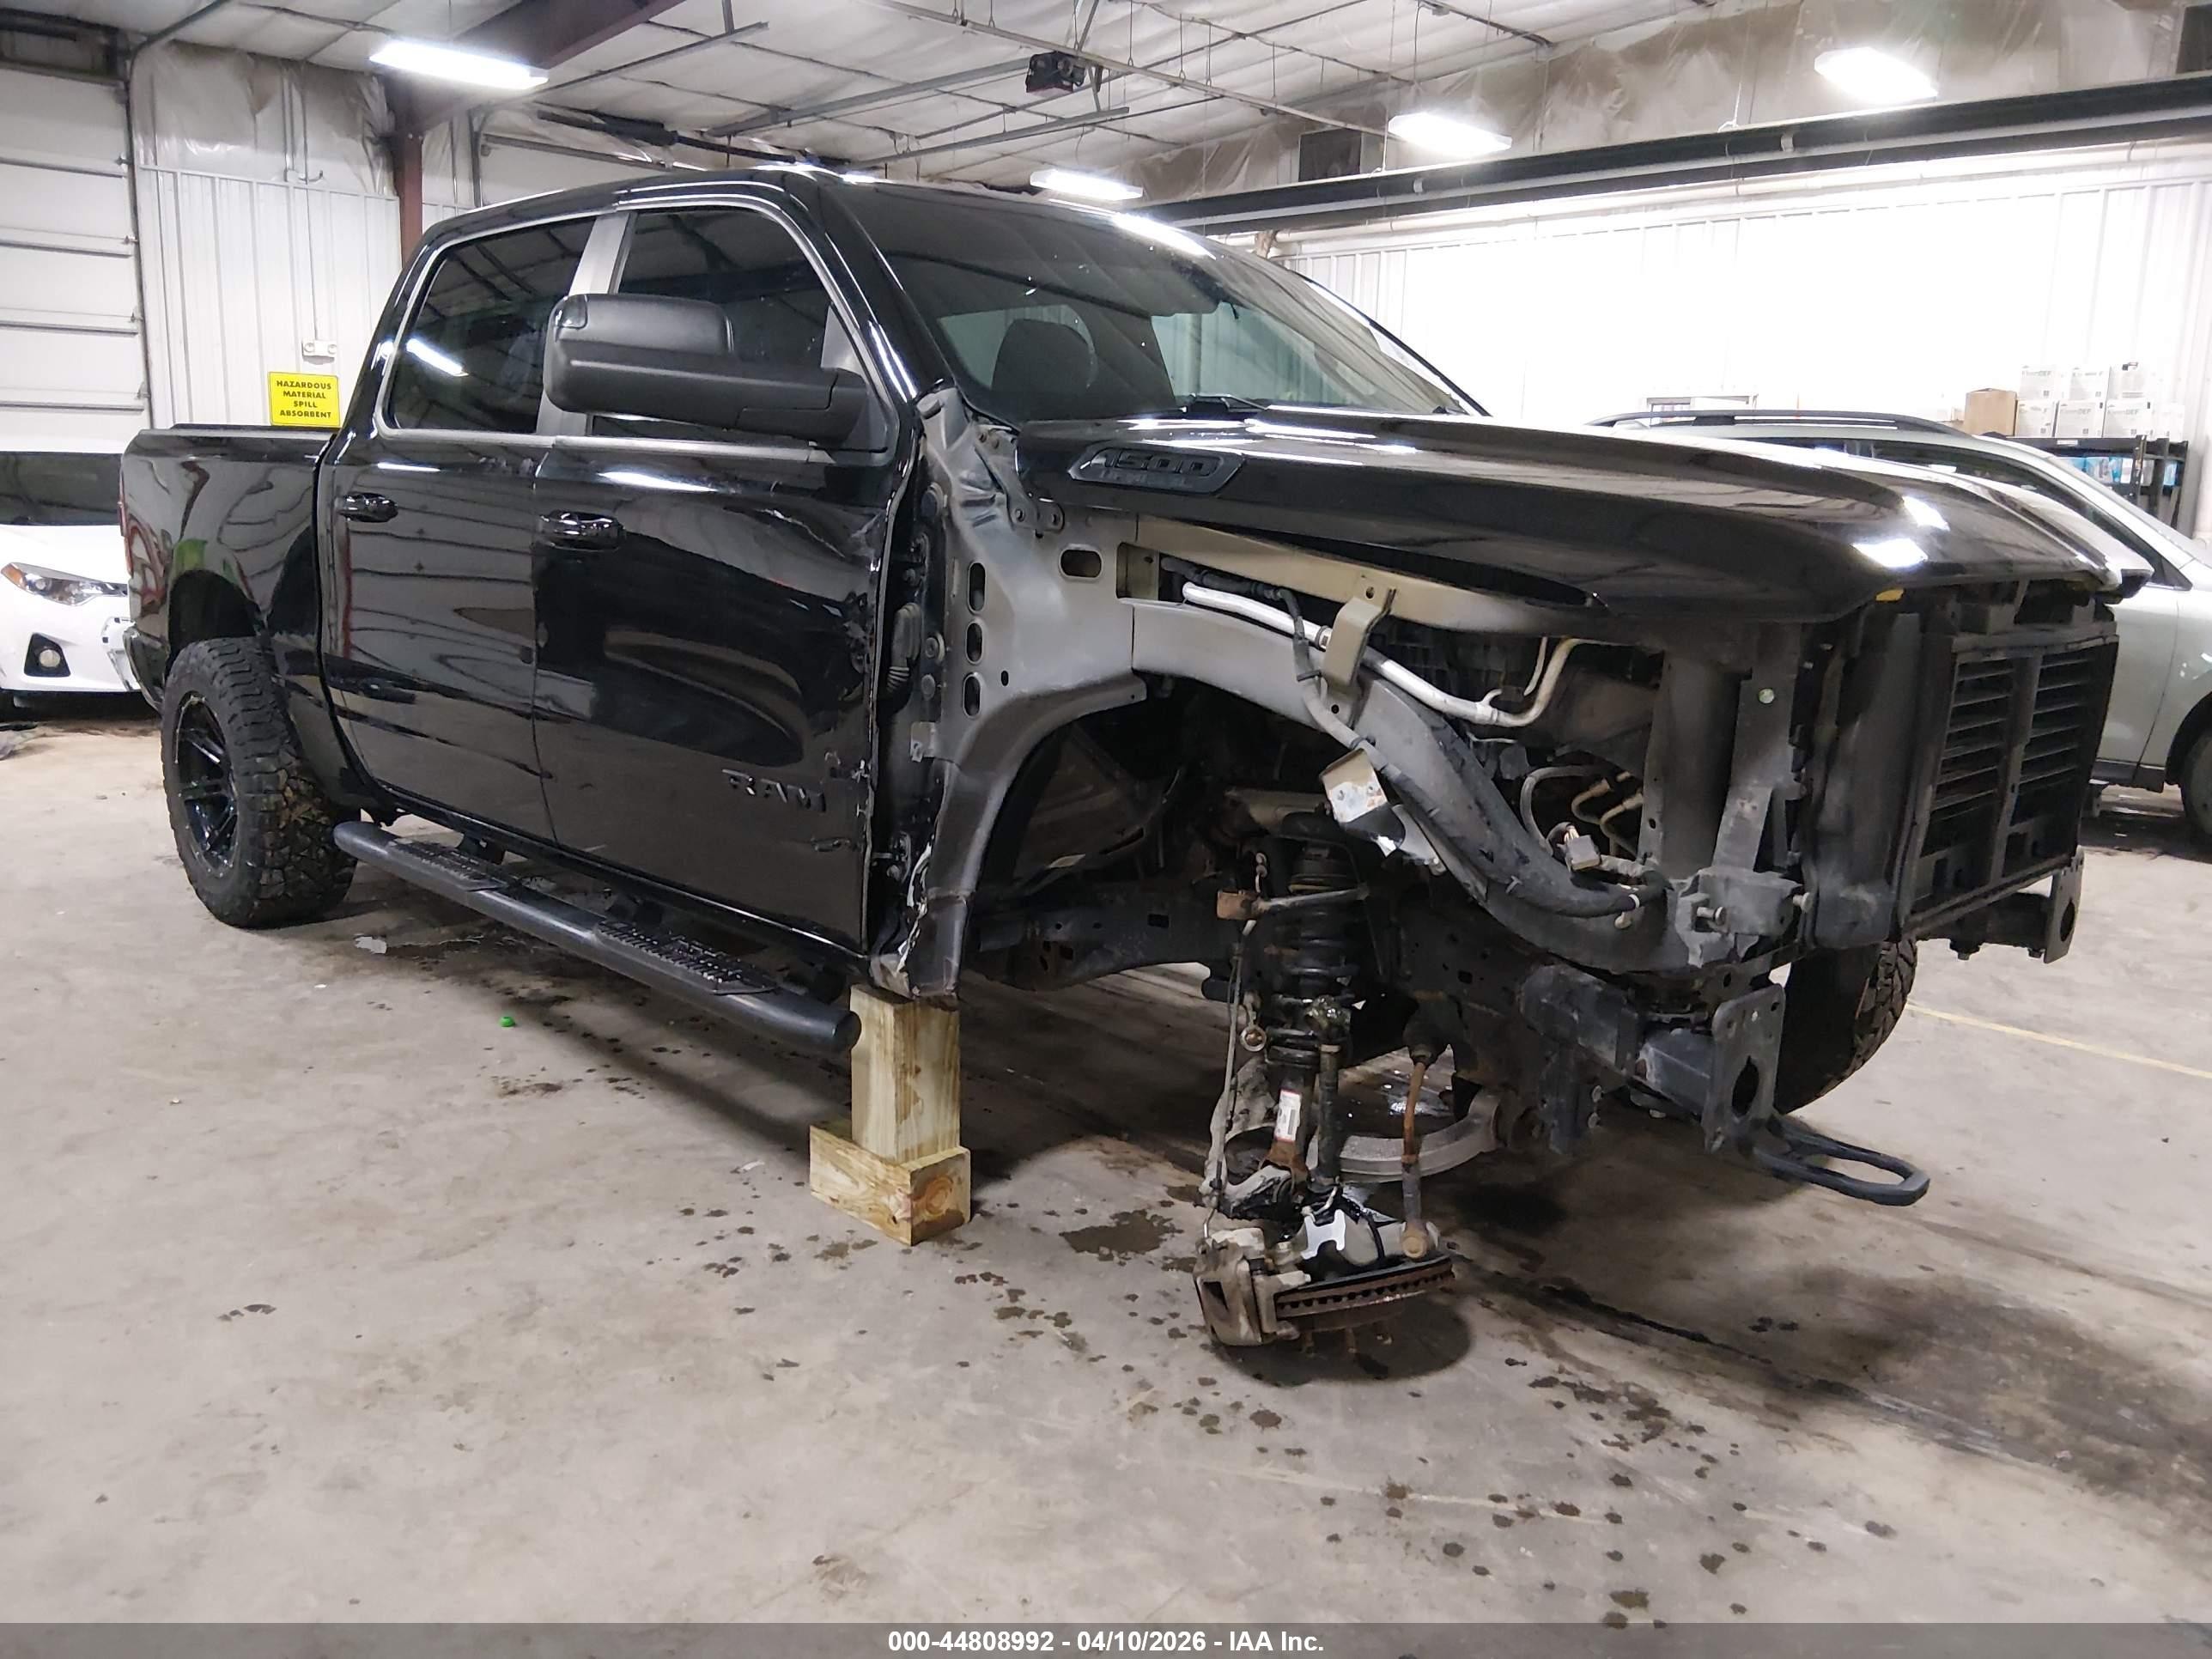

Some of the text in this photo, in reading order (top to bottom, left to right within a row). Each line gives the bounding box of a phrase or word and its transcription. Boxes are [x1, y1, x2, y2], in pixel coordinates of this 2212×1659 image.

[276, 380, 332, 390] HAZARDOUS
[283, 390, 326, 399] MATERIAL
[279, 409, 332, 418] ABSORBENT
[1091, 448, 1224, 477] 1500
[721, 769, 826, 812] RAM
